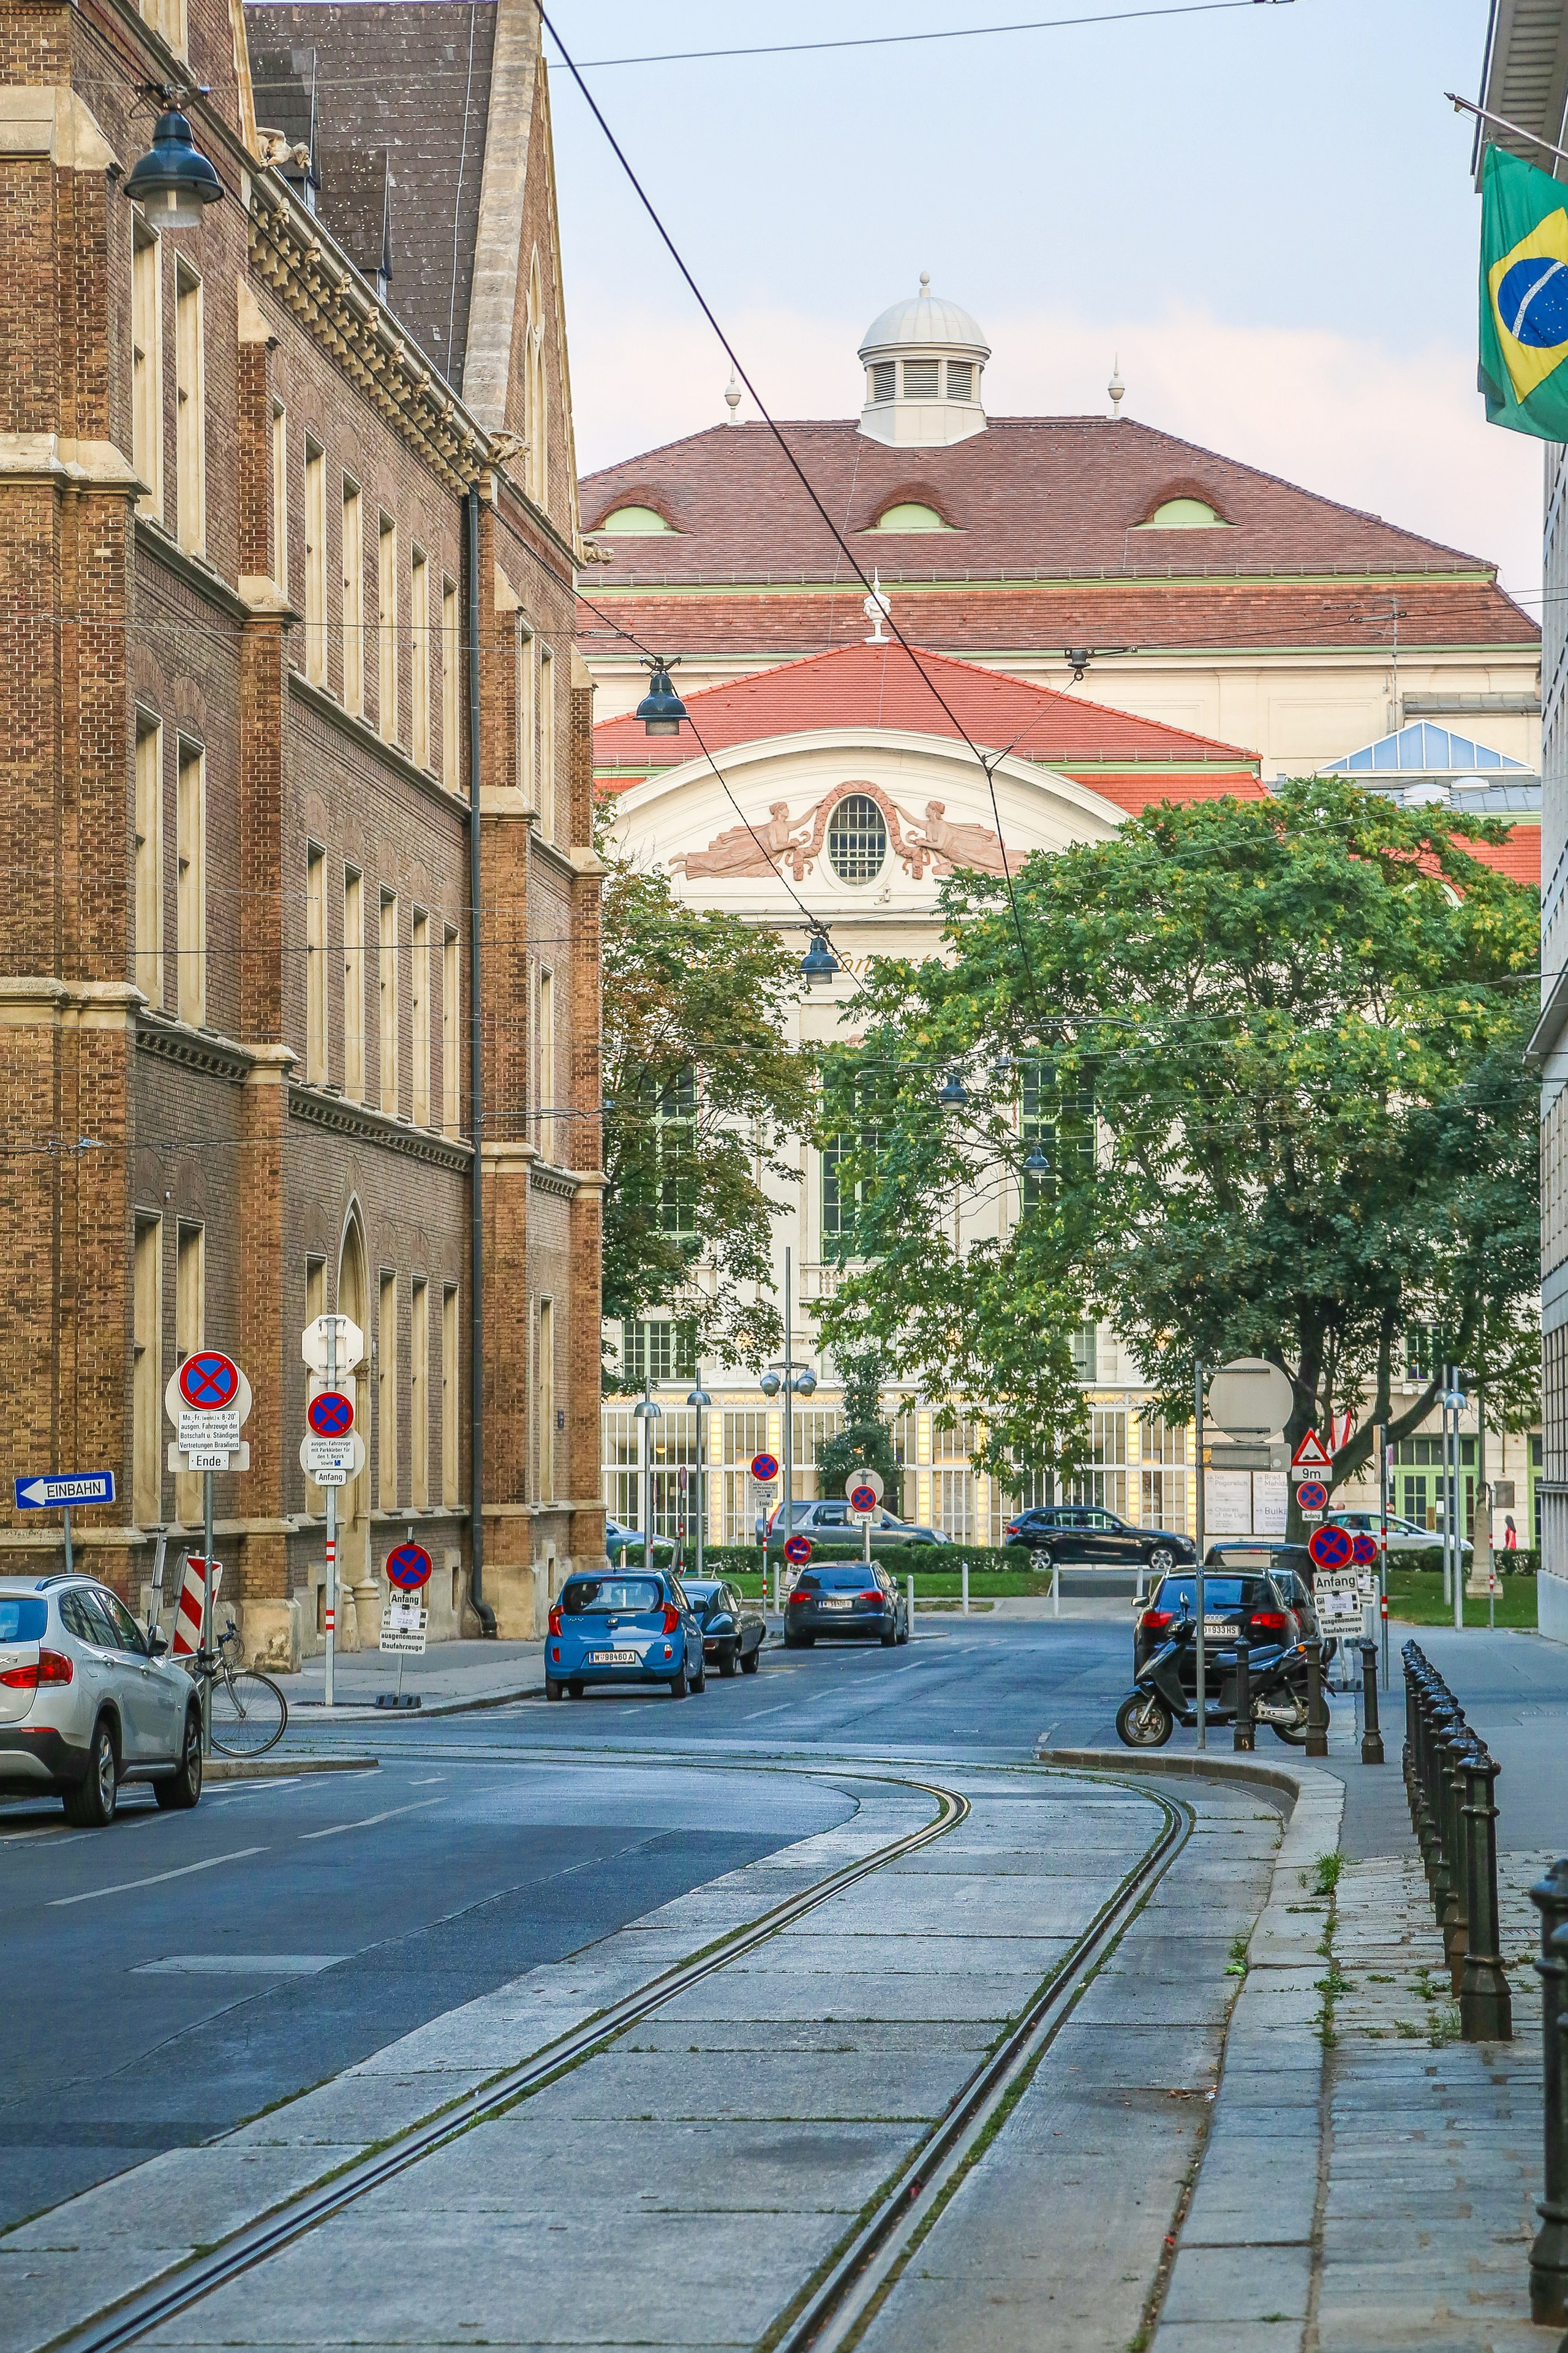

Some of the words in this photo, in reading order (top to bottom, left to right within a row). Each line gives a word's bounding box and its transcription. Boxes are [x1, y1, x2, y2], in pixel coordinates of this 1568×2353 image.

[1513, 308, 1525, 334] ORDEM
[196, 1455, 221, 1467] Ende
[318, 1473, 343, 1482] Anfang
[1302, 1468, 1321, 1479] 9m
[47, 1481, 102, 1498] EINBAHN
[1316, 1576, 1355, 1587] Anfang
[391, 1594, 419, 1605] Anfang
[382, 1642, 423, 1652] Baufahrzeuge
